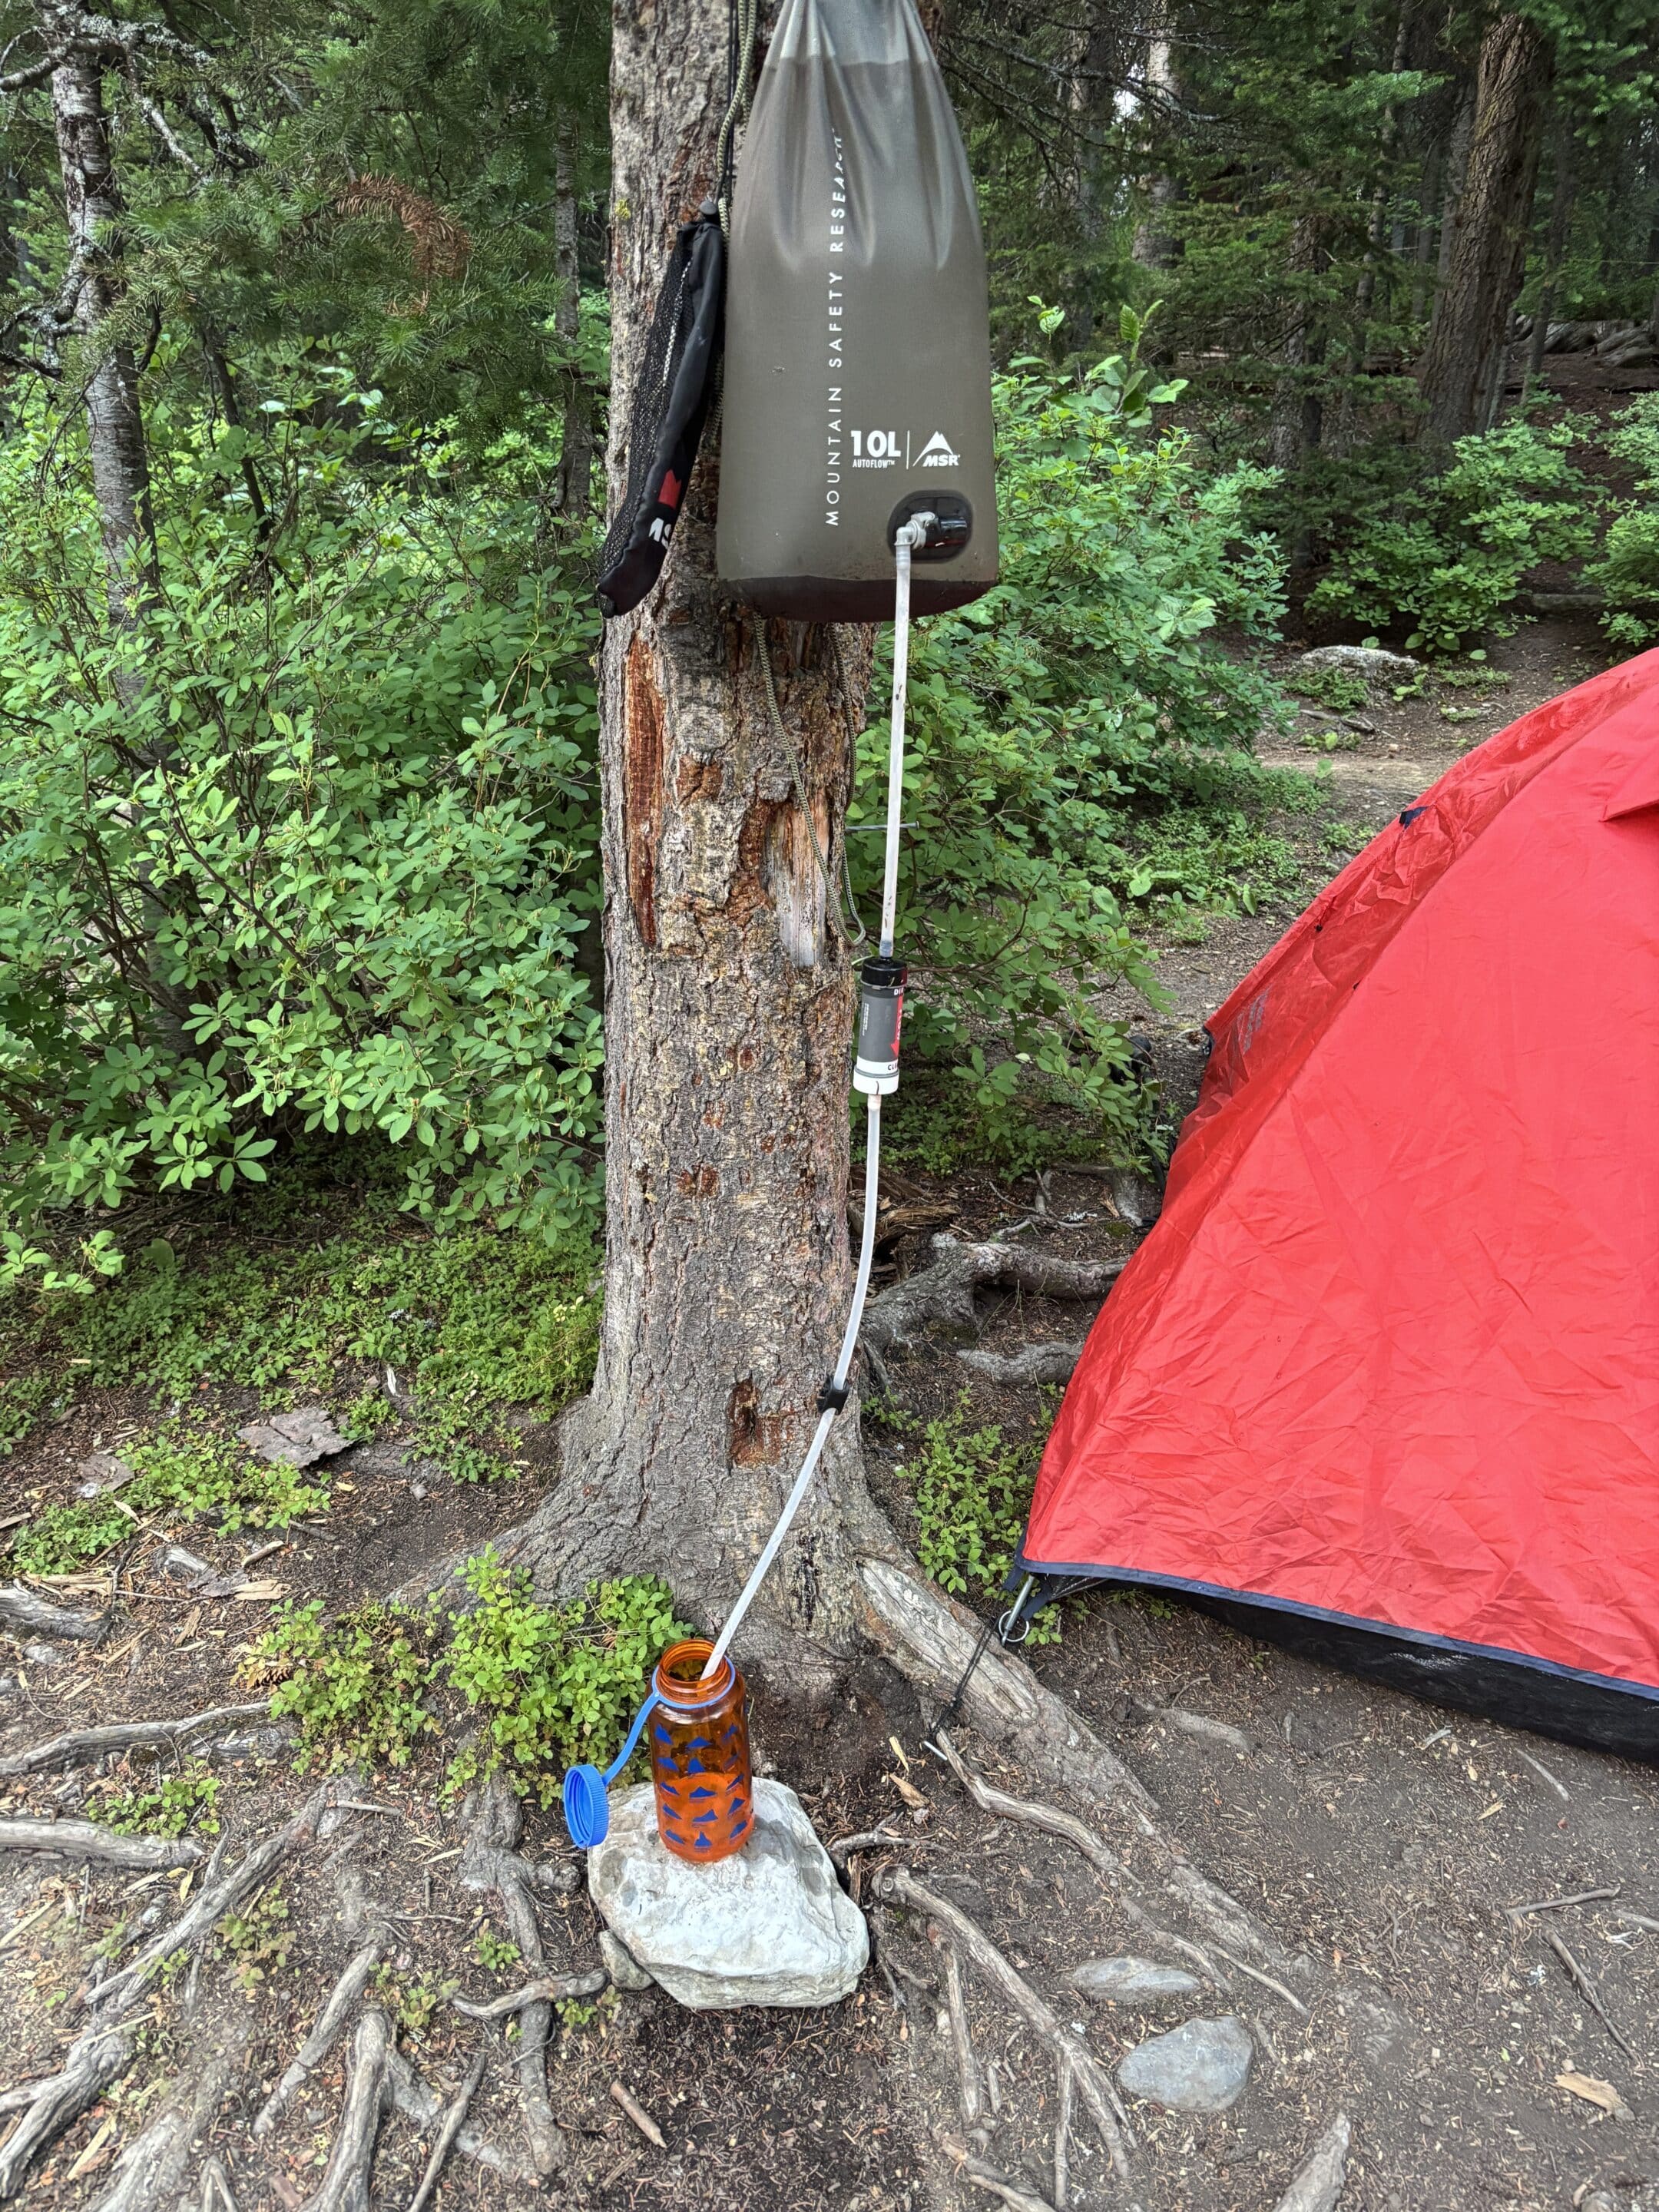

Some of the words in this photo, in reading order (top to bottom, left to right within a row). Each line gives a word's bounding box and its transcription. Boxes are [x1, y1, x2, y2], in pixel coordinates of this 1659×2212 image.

[829, 272, 843, 368] SAFETY
[825, 387, 842, 526] MOUNTAIN
[850, 430, 901, 458] 10L
